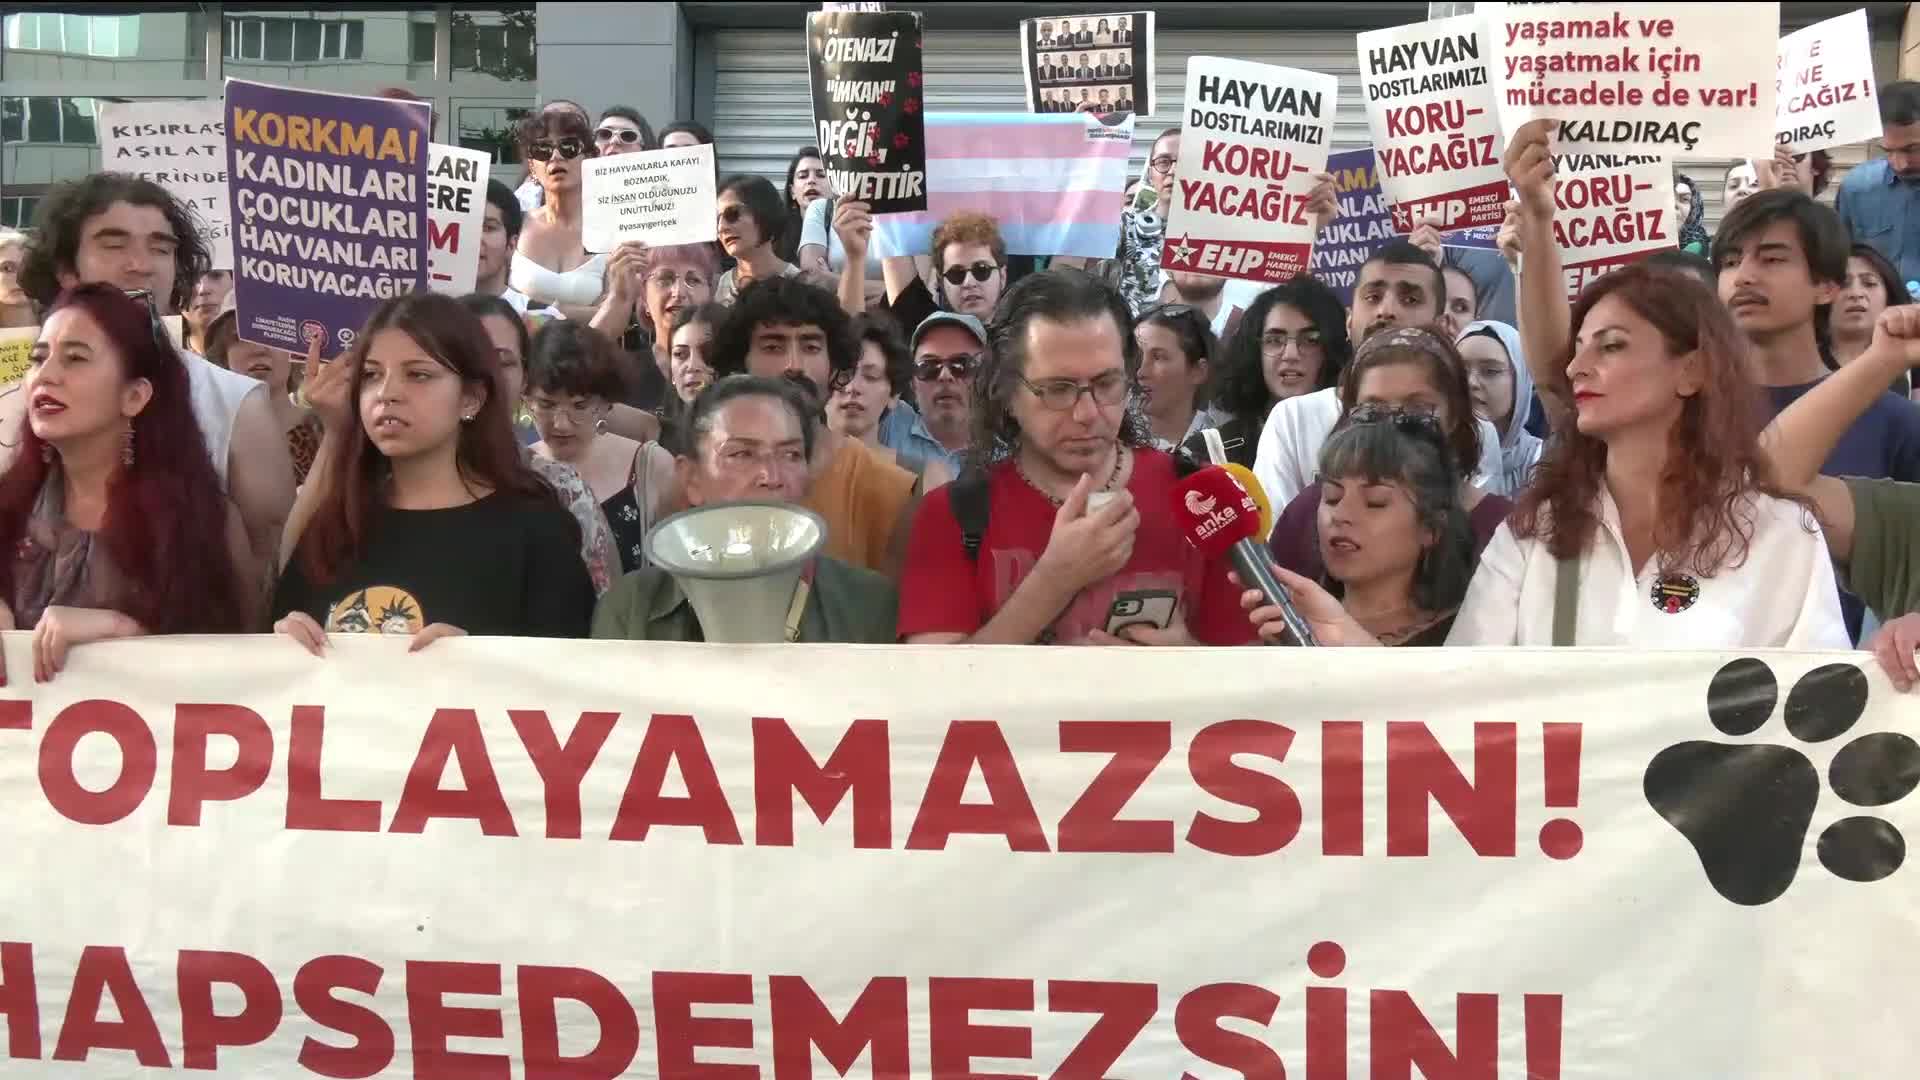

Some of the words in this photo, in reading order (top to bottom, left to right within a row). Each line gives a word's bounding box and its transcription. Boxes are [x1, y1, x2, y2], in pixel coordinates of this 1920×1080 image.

[824, 28, 898, 63] ÖTENAZİ
[1505, 12, 1629, 47] yaşamak
[1638, 19, 1674, 38] ve
[1368, 33, 1480, 76] HAYVAN
[1505, 46, 1640, 80] yaşatmak
[1649, 46, 1700, 79] için
[1199, 75, 1322, 118] HAYVAN
[1368, 66, 1488, 102] DOSTLARIMIZI
[1506, 80, 1643, 106] mücadele
[1652, 80, 1689, 106] de
[1699, 82, 1757, 107] var!
[233, 106, 418, 165] KORKMA!
[1190, 109, 1324, 145] DOSTLARIMIZI
[1386, 100, 1484, 139] KORU-
[1558, 120, 1701, 151] KALDIRAÇ
[1776, 120, 1836, 146] DIRAÇ
[609, 160, 668, 174] HAYVANLARLA
[1202, 140, 1309, 181] KORU-
[1378, 133, 1499, 178] YACAĞIZ
[235, 149, 418, 203] KADINLARI
[238, 188, 418, 240] ÇOCUKLARI
[1180, 179, 1313, 226] YACAĞIZ
[239, 223, 418, 271] HAYVANLARI
[1198, 243, 1265, 274] EHP
[1195, 506, 1235, 537] anka
